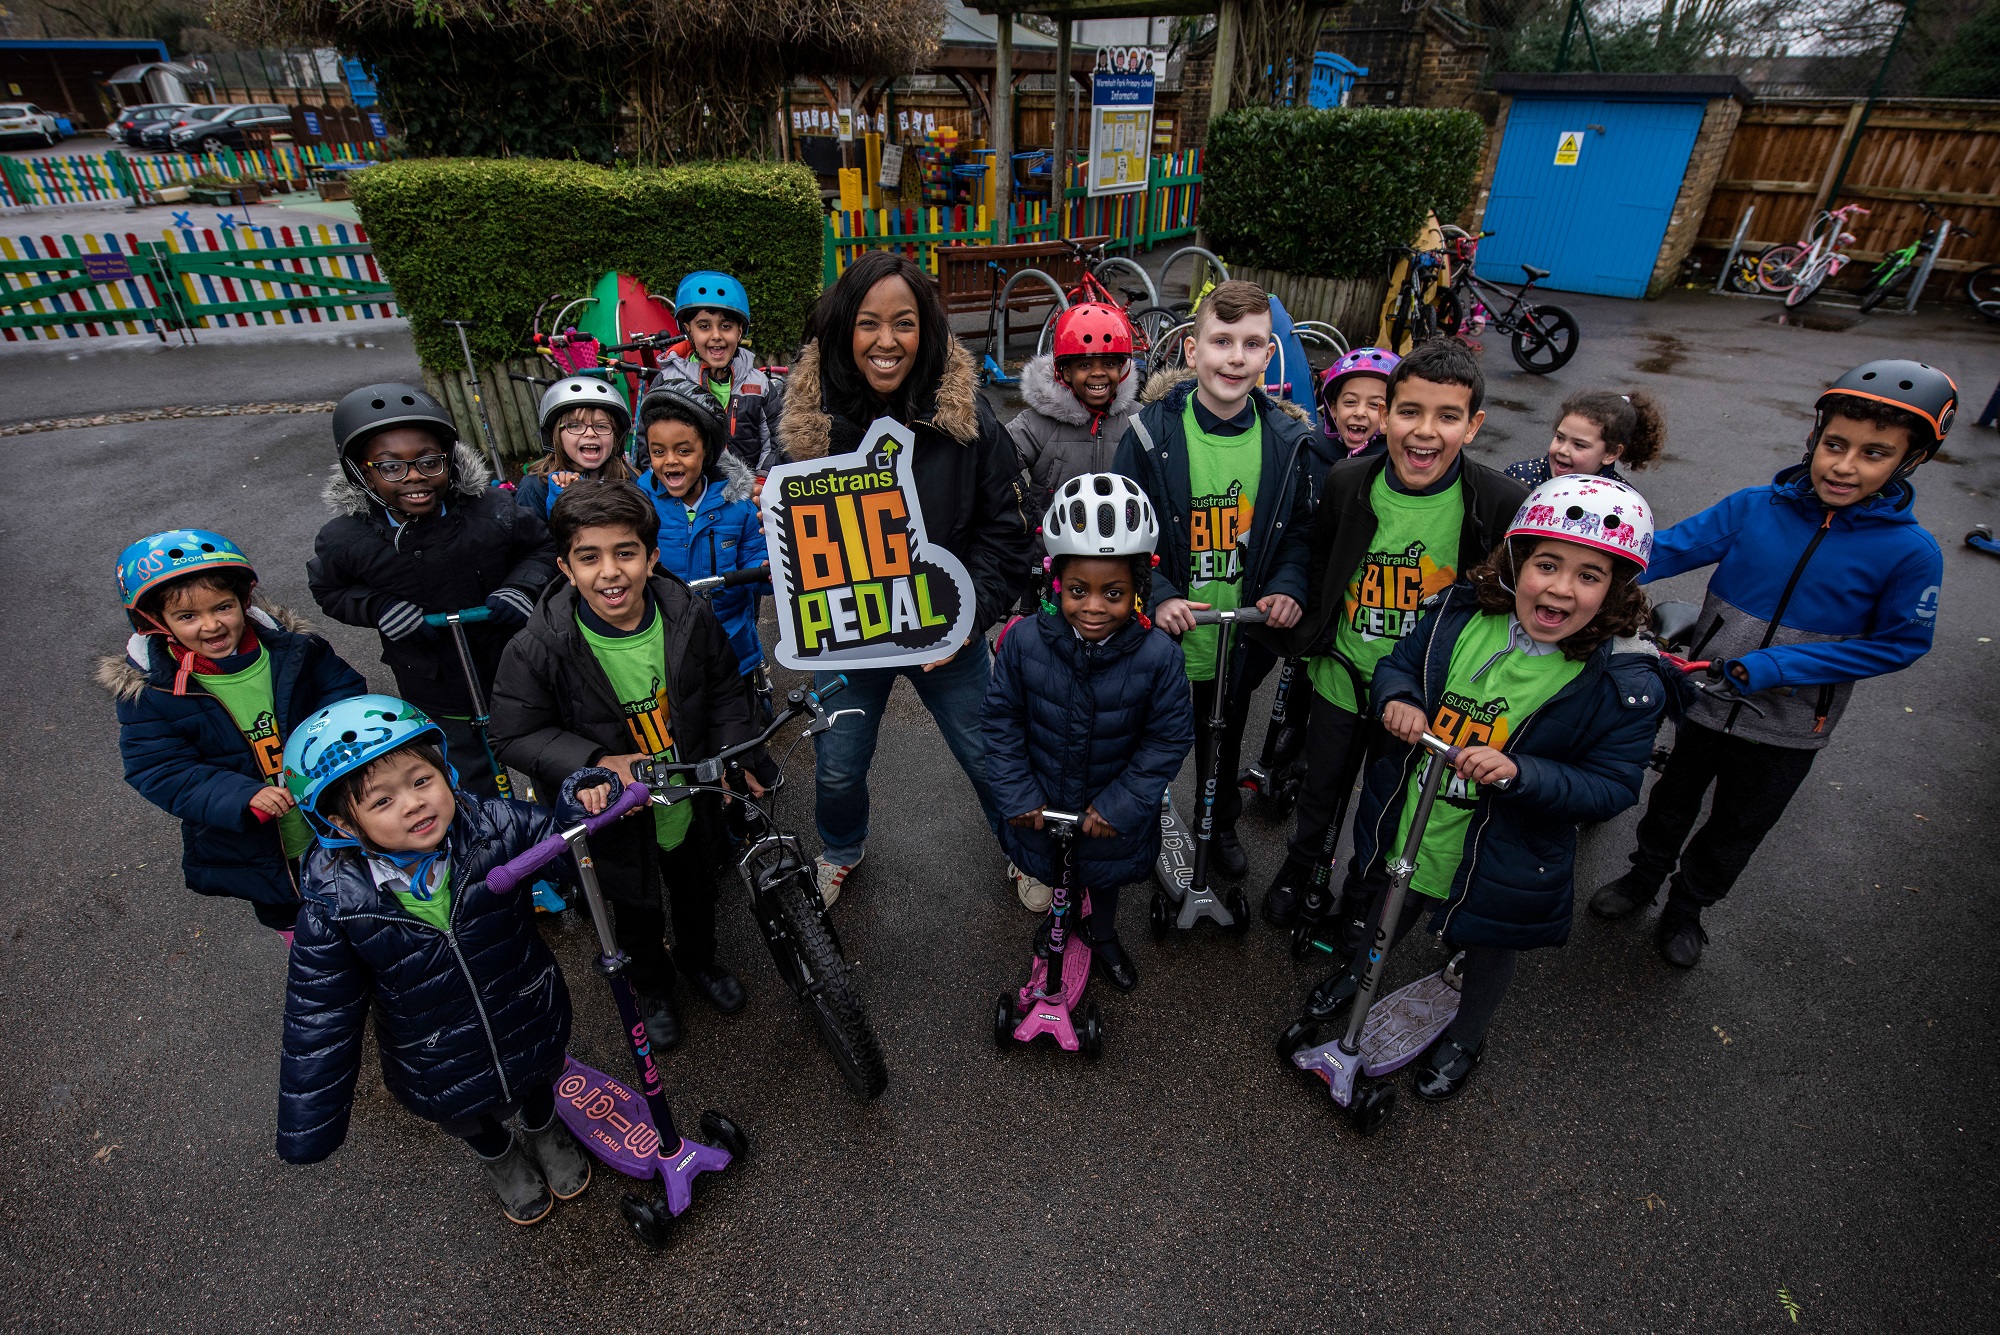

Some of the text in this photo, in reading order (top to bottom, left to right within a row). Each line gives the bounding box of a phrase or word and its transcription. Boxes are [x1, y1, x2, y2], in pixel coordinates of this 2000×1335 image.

[1111, 90, 1139, 100] Information
[1117, 78, 1125, 87] Park
[1126, 78, 1140, 89] Primary
[1141, 79, 1154, 87] School
[788, 470, 894, 498] sustrans
[1191, 496, 1237, 507] sustrans
[791, 490, 911, 591] BIG
[1191, 507, 1238, 551] BIG
[1366, 554, 1417, 567] sustrans
[1360, 564, 1421, 610] BIG
[798, 573, 948, 649] PEDAL
[604, 1080, 632, 1102] maxi
[590, 1128, 622, 1153] maxi
